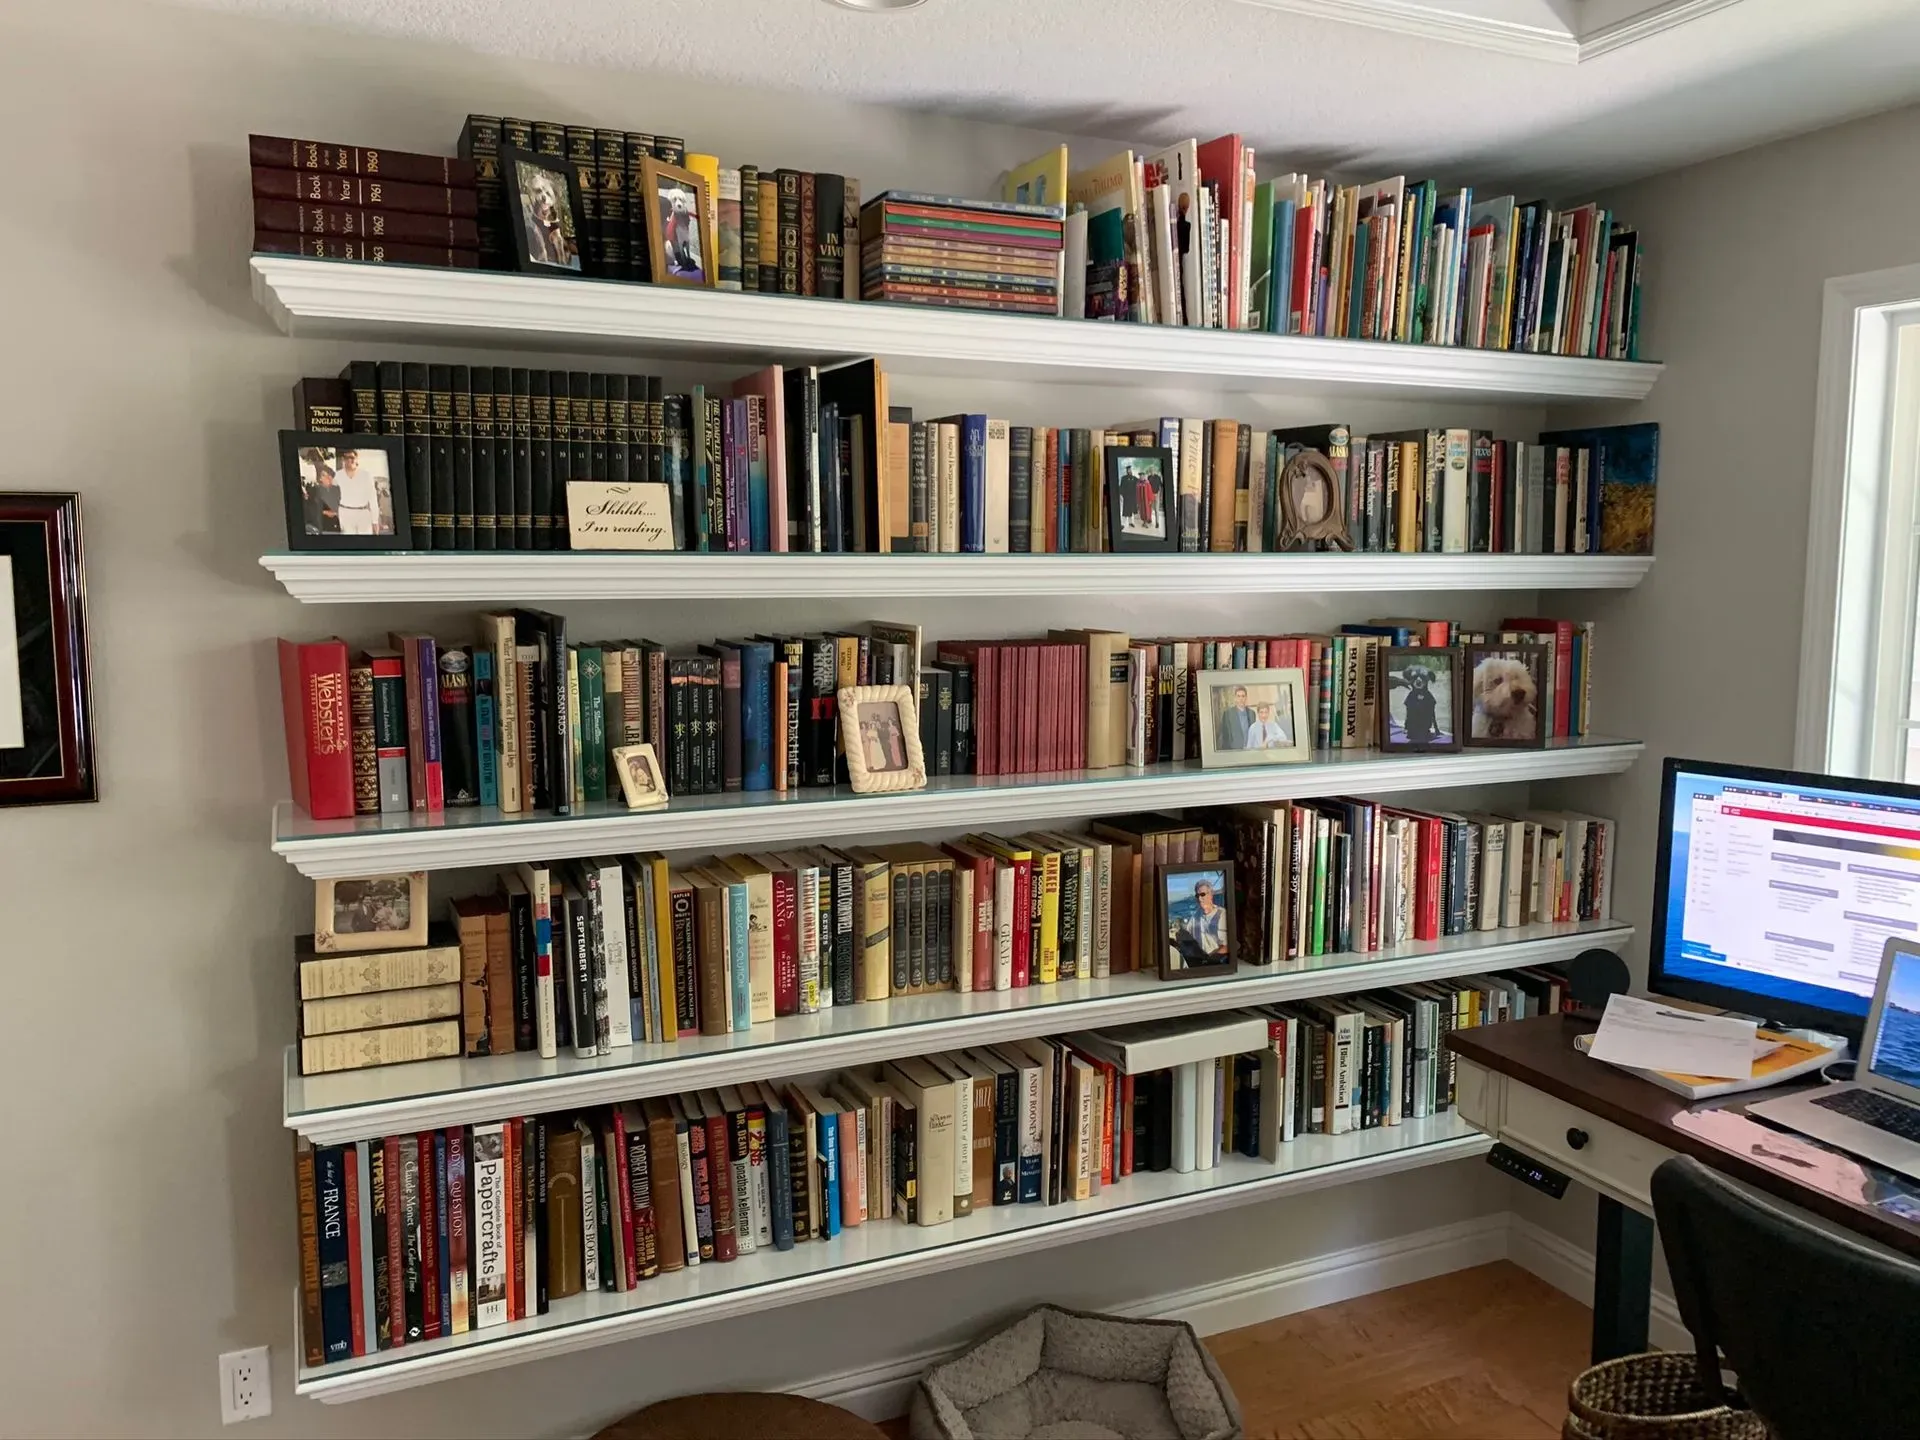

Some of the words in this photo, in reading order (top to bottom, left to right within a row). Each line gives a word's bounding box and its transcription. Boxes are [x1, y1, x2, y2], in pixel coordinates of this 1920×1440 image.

[305, 143, 318, 169] Book
[337, 147, 347, 169] Year
[366, 150, 378, 173] 1960
[310, 174, 321, 200] Book
[340, 178, 351, 201] Year
[370, 183, 382, 203] 1961
[312, 207, 324, 233] Book
[343, 212, 353, 234] Year
[373, 215, 384, 237] 1962
[315, 238, 325, 258] ook
[820, 245, 843, 257] VIVO
[827, 233, 839, 244] IN
[713, 398, 721, 416] THE
[749, 398, 757, 423] CLIVE
[758, 398, 766, 421] DEEP
[311, 425, 343, 433] Dictionary
[713, 417, 722, 462] COMPLETE
[1328, 447, 1348, 458] ALASKA
[1367, 451, 1377, 471] James
[1435, 435, 1445, 470] SPACE
[1474, 447, 1492, 457] TEXAS
[714, 463, 722, 487] BOOK
[1368, 471, 1377, 480] A.
[714, 487, 722, 495] of
[1366, 480, 1375, 517] Michener
[715, 497, 724, 534] RUNNING
[578, 521, 608, 533] I'm
[613, 521, 667, 542] reading.
[504, 637, 512, 656] Walter
[1364, 642, 1375, 672] NAKED
[813, 653, 823, 686] KING
[821, 641, 834, 694] STEPHEN
[1348, 647, 1357, 688] BLACK
[506, 693, 515, 707] Book
[522, 662, 535, 717] BIPOLAR
[1364, 674, 1375, 700] CAME
[318, 673, 336, 754] Webster's
[788, 700, 799, 719] The
[811, 698, 834, 719] IT
[1176, 668, 1186, 735] NABOKOV
[1346, 688, 1357, 738] SUNDAY
[506, 717, 516, 740] Puppies
[594, 710, 602, 744] Silmarillion
[788, 719, 798, 742] Dark
[507, 742, 516, 753] and
[526, 720, 536, 762] CHILD
[788, 744, 799, 765] Half
[507, 754, 516, 768] Dogs
[1291, 827, 1300, 872] ULTIMATE
[838, 866, 852, 897] PATRICIA
[1046, 857, 1057, 893] BANKER
[1468, 842, 1480, 898] Thousand
[803, 874, 813, 910] PATRICIA
[1064, 878, 1072, 910] WHITE
[1290, 875, 1300, 893] Spy
[735, 899, 743, 914] THE
[776, 880, 786, 927] CHANG
[786, 887, 795, 919] IRIS
[1101, 887, 1109, 918] HOME
[735, 915, 744, 945] SUGAR
[838, 898, 852, 935] CORNWELL
[1063, 911, 1071, 943] HOUSE
[1466, 903, 1476, 930] Days
[576, 915, 586, 971] SEPTEMBER
[803, 912, 816, 954] CORNWELL
[1001, 924, 1010, 966] GRAB
[1098, 920, 1108, 950] HINTS
[736, 948, 745, 988] SOLUTION
[781, 951, 786, 959] IN
[521, 965, 527, 974] My
[580, 973, 587, 982] 11
[1339, 1047, 1348, 1069] Blind
[1029, 1072, 1037, 1099] ANDY
[1338, 1071, 1347, 1103] Ambition
[736, 1113, 746, 1128] DR.
[1029, 1100, 1037, 1137] ROONEY
[1081, 1124, 1089, 1138] Say
[1083, 1114, 1089, 1122] to
[451, 1139, 462, 1168] BODY
[680, 1142, 689, 1170] Biology
[737, 1131, 747, 1156] DEATH
[629, 1145, 646, 1176] ROBERT
[372, 1149, 386, 1217] TYPEWISE
[405, 1161, 414, 1194] Claude
[734, 1163, 749, 1197] jonathan
[425, 1202, 431, 1210] IN
[494, 1190, 502, 1222] Complete
[633, 1177, 649, 1210] LUDLUM
[323, 1189, 340, 1239] FRANCE
[406, 1196, 415, 1226] Monet
[424, 1211, 432, 1229] ITALY
[452, 1181, 462, 1237] QUESTION
[478, 1163, 497, 1275] Papercrafts
[584, 1188, 594, 1230] TOASTS
[600, 1201, 609, 1225] Grilling
[738, 1198, 750, 1236] kellerman
[408, 1248, 416, 1268] Color
[496, 1241, 502, 1249] of
[586, 1233, 595, 1266] BOOK
[636, 1227, 645, 1265] PROTOCOL
[645, 1234, 655, 1260] SIGMA
[376, 1256, 389, 1313] HINRICHS
[409, 1277, 417, 1292] Time
